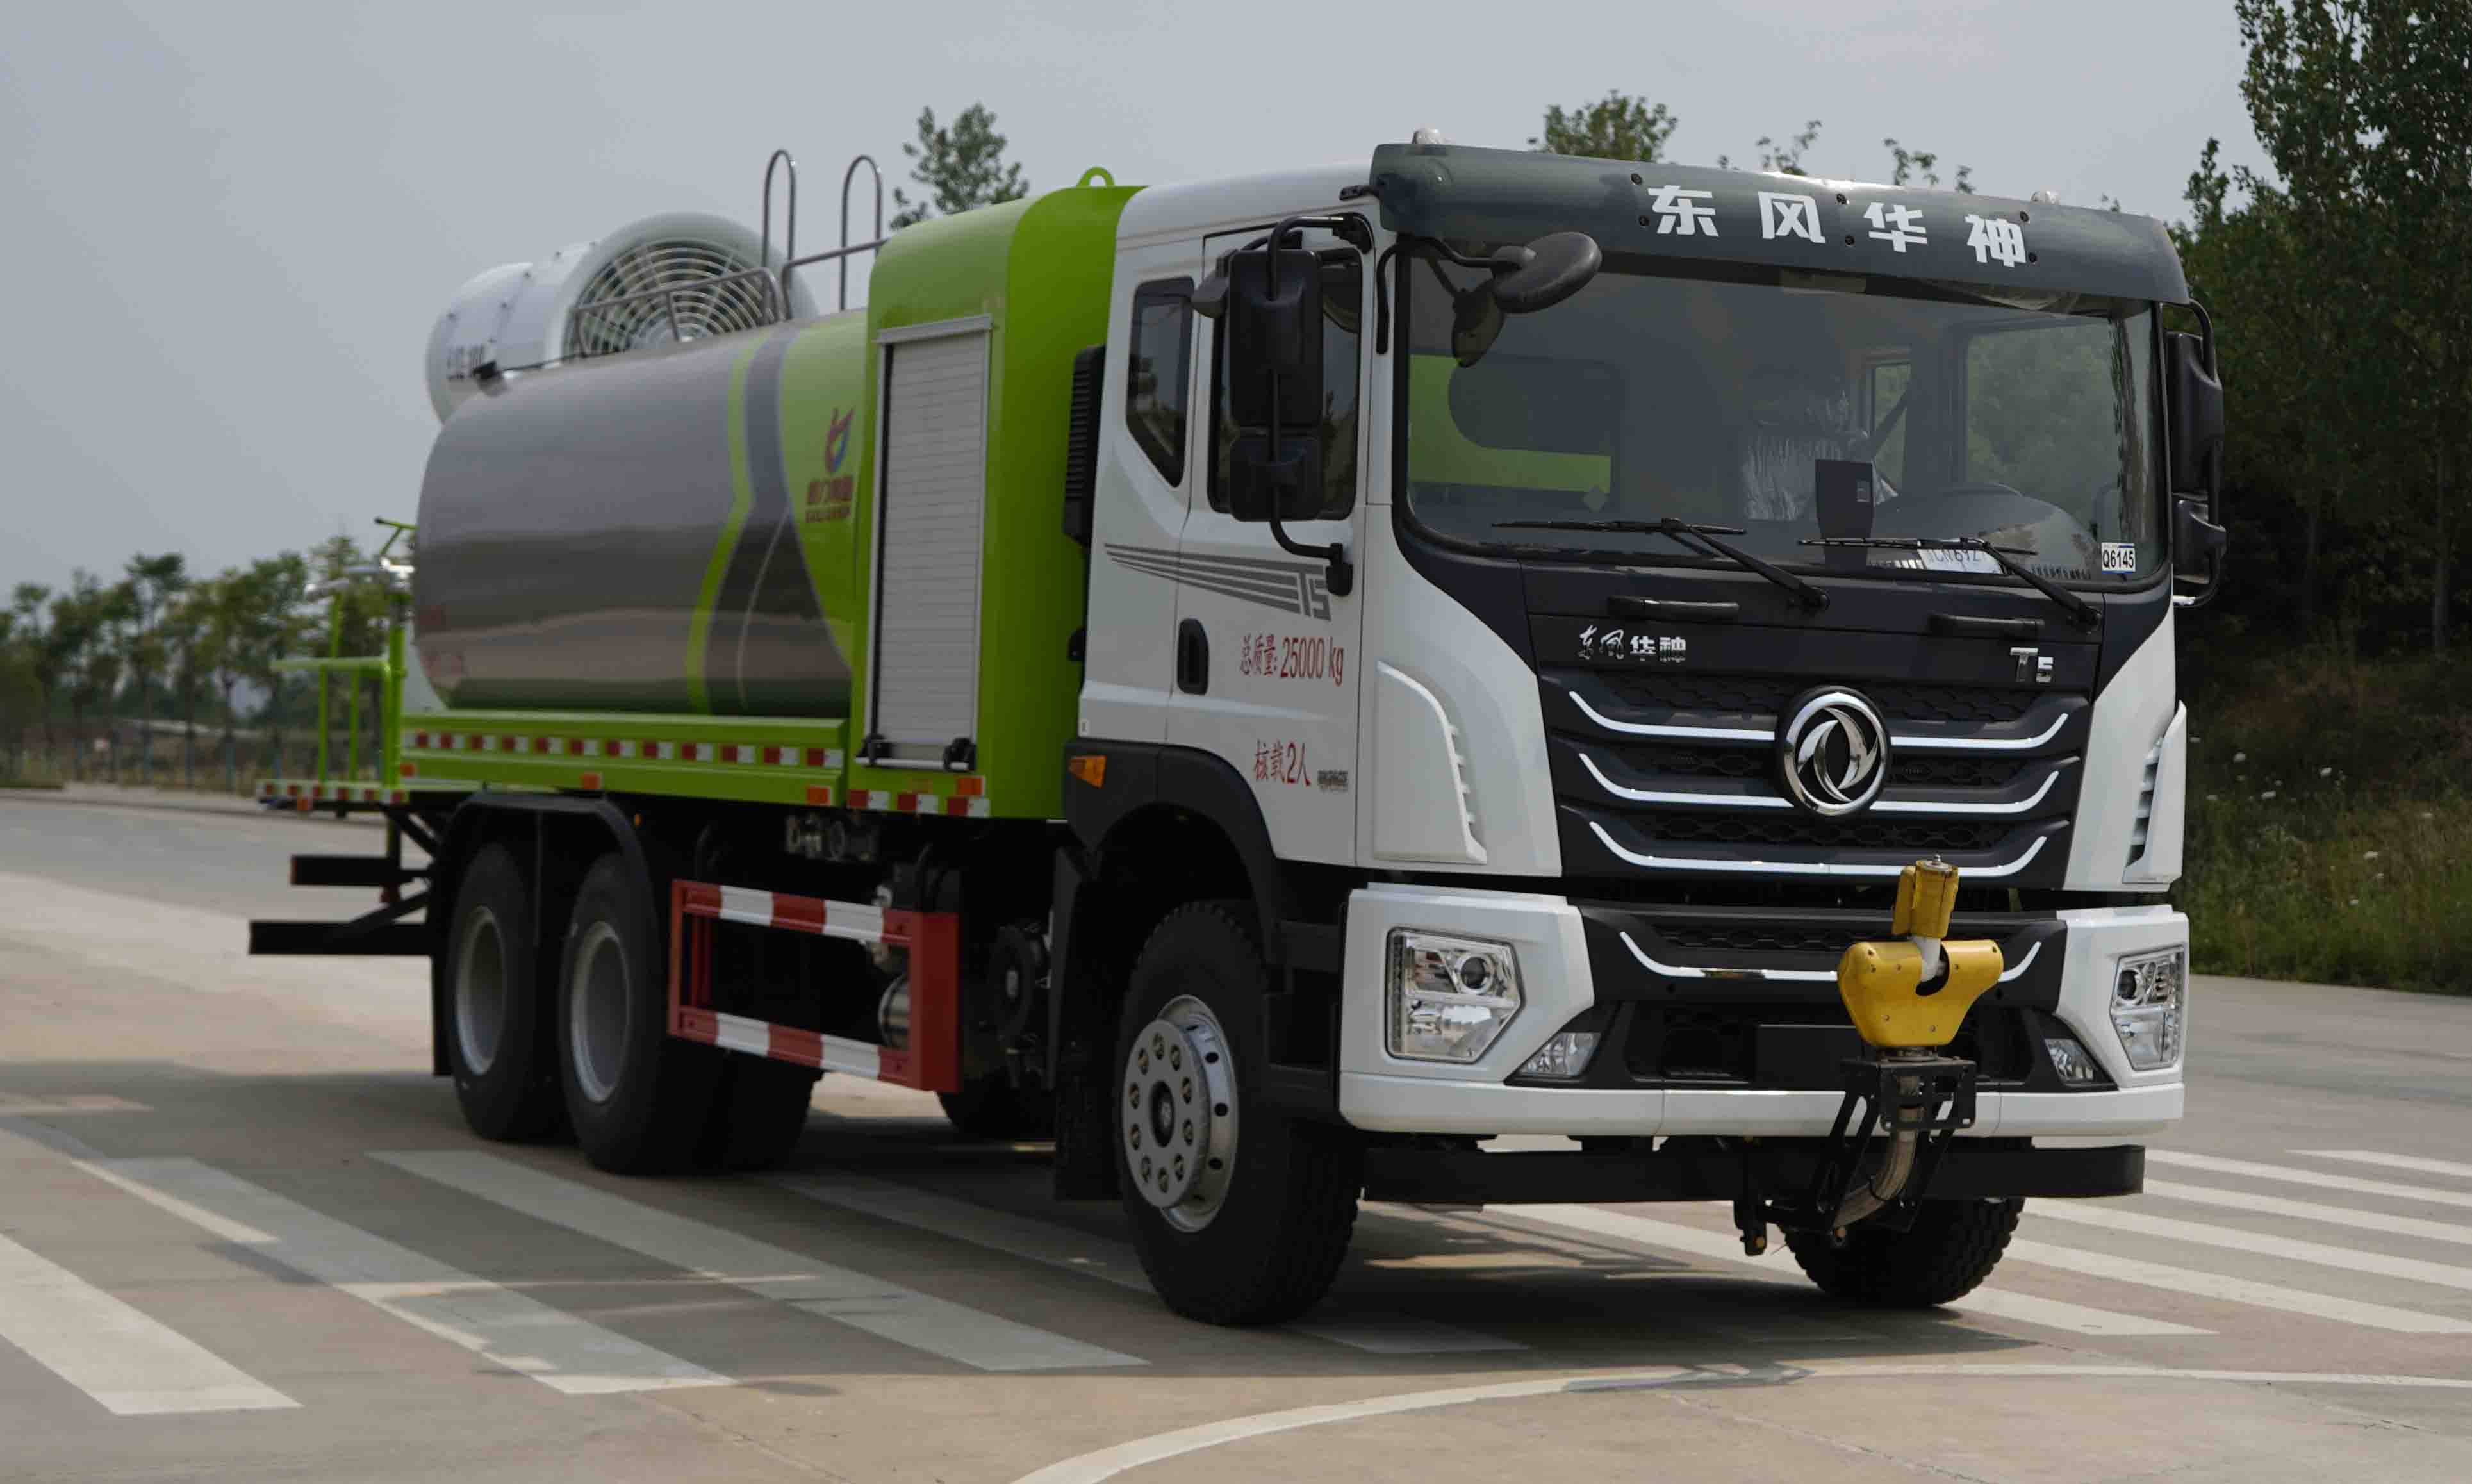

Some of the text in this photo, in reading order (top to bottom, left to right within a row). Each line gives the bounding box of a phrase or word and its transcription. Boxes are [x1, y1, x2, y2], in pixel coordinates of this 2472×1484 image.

[1647, 185, 2027, 267] 东风华神
[2102, 550, 2134, 568] Q6145
